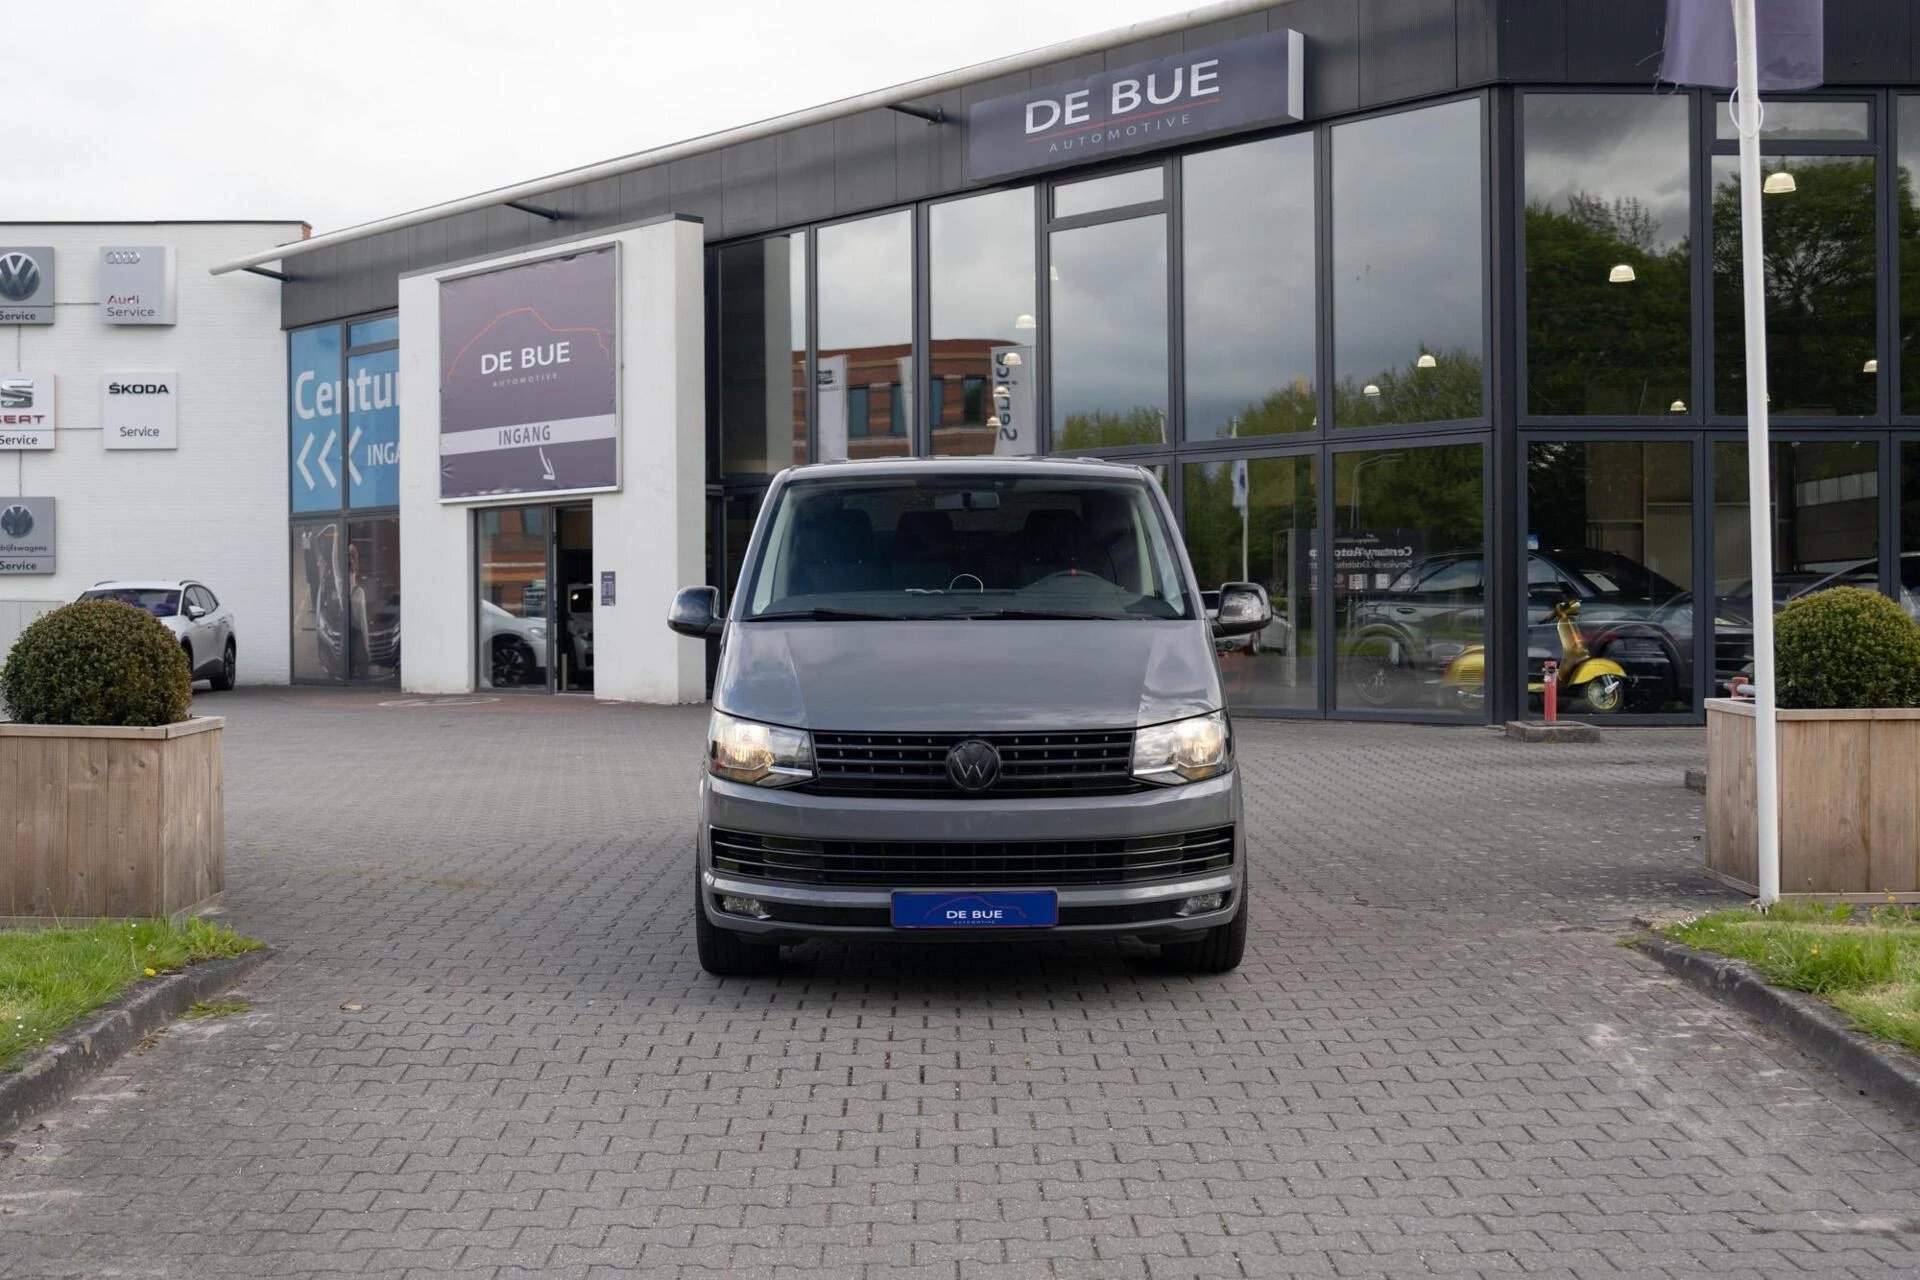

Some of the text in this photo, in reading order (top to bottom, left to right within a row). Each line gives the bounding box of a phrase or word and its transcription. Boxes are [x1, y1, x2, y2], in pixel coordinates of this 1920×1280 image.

[1025, 59, 1220, 134] DE BUE
[1049, 112, 1191, 153] AUTOMOTIVE
[107, 295, 139, 304] Audi
[0, 310, 36, 321] Service
[106, 307, 155, 317] Service
[481, 341, 571, 375] DE BUE
[492, 372, 557, 387] AUTOMOTIVE
[108, 382, 170, 395] ŠKODA
[119, 426, 160, 437] Service
[499, 424, 551, 446] INGANG
[0, 434, 38, 445] Service
[0, 560, 37, 570] Service
[946, 910, 1003, 919] DE BUE
